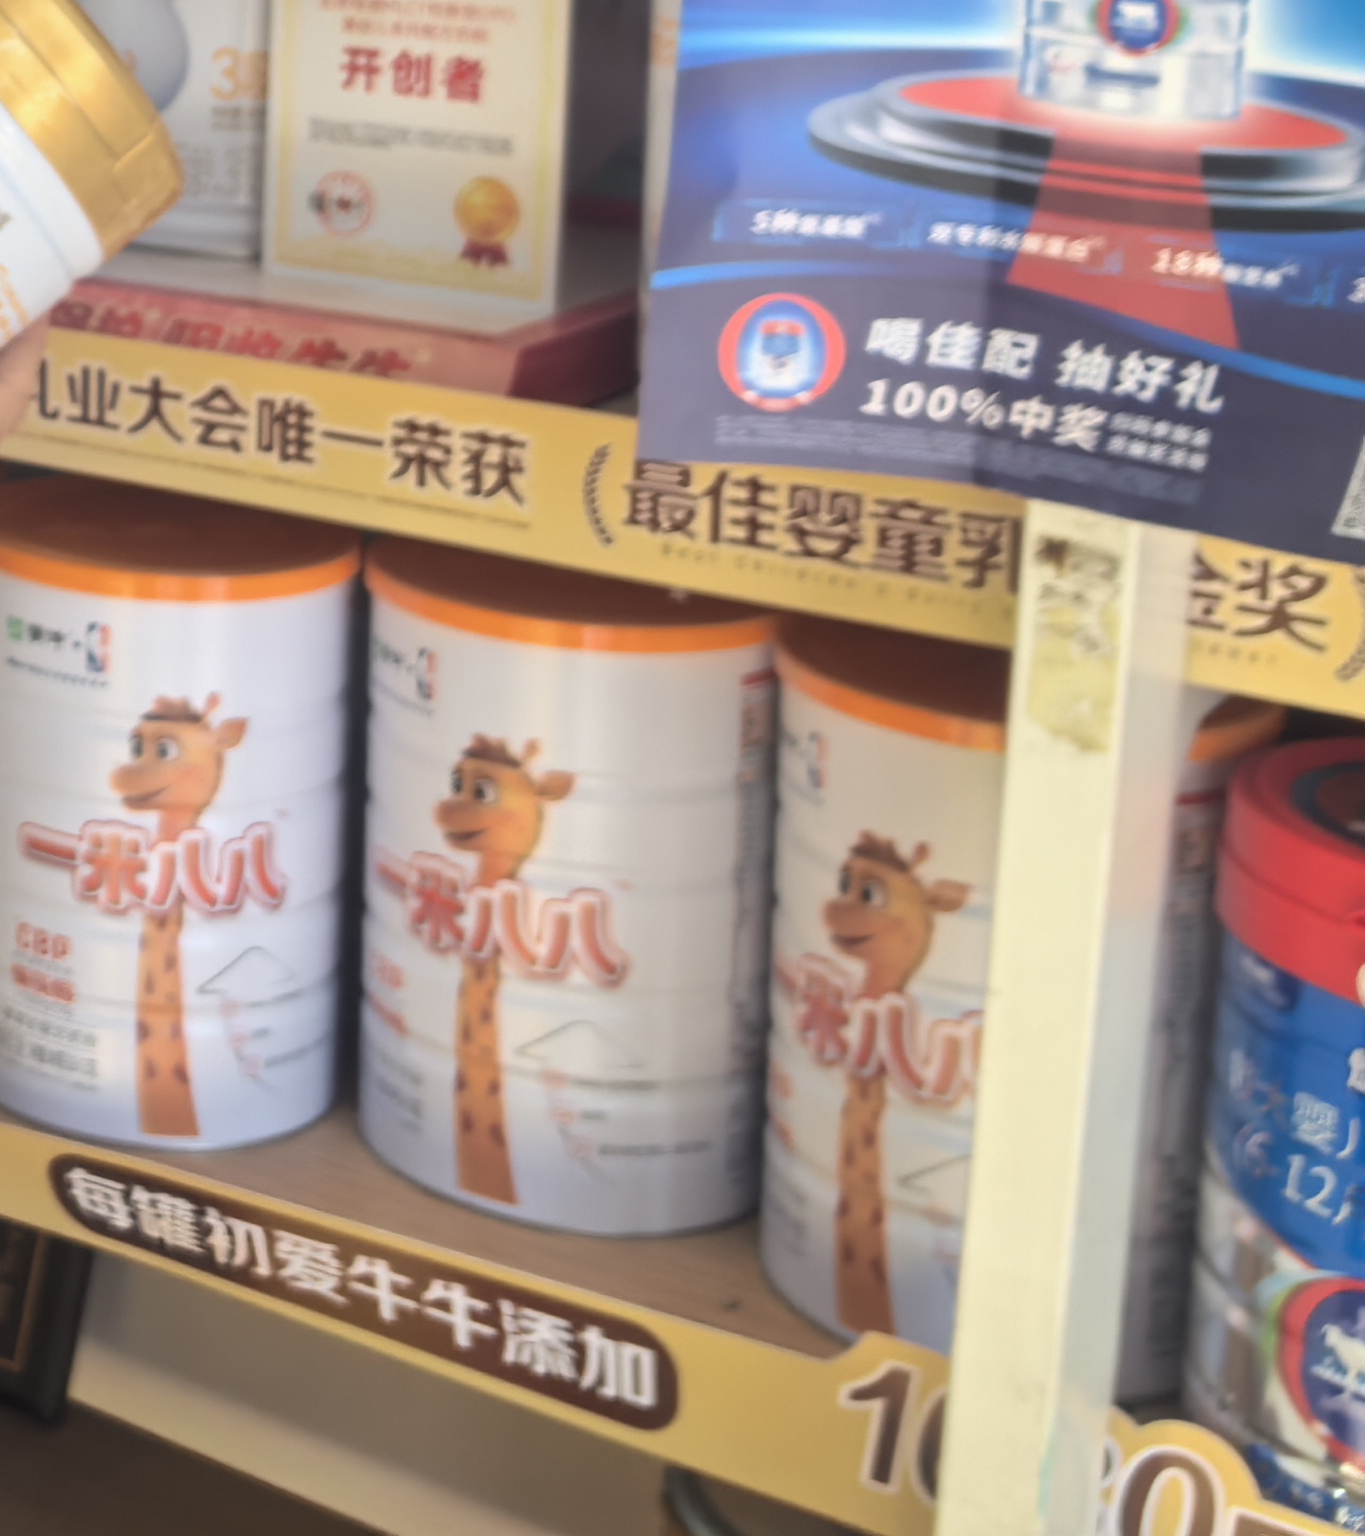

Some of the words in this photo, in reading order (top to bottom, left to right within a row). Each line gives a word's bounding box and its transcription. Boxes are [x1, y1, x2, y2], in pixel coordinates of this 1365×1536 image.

[339, 44, 486, 106] 开创者
[859, 378, 1107, 454] 100%中奖
[1055, 339, 1225, 414] 抽好礼
[17, 820, 287, 916] 一米八八
[375, 852, 633, 989] 一米八八
[65, 1165, 659, 1412] 每罐初爱牛牛添加
